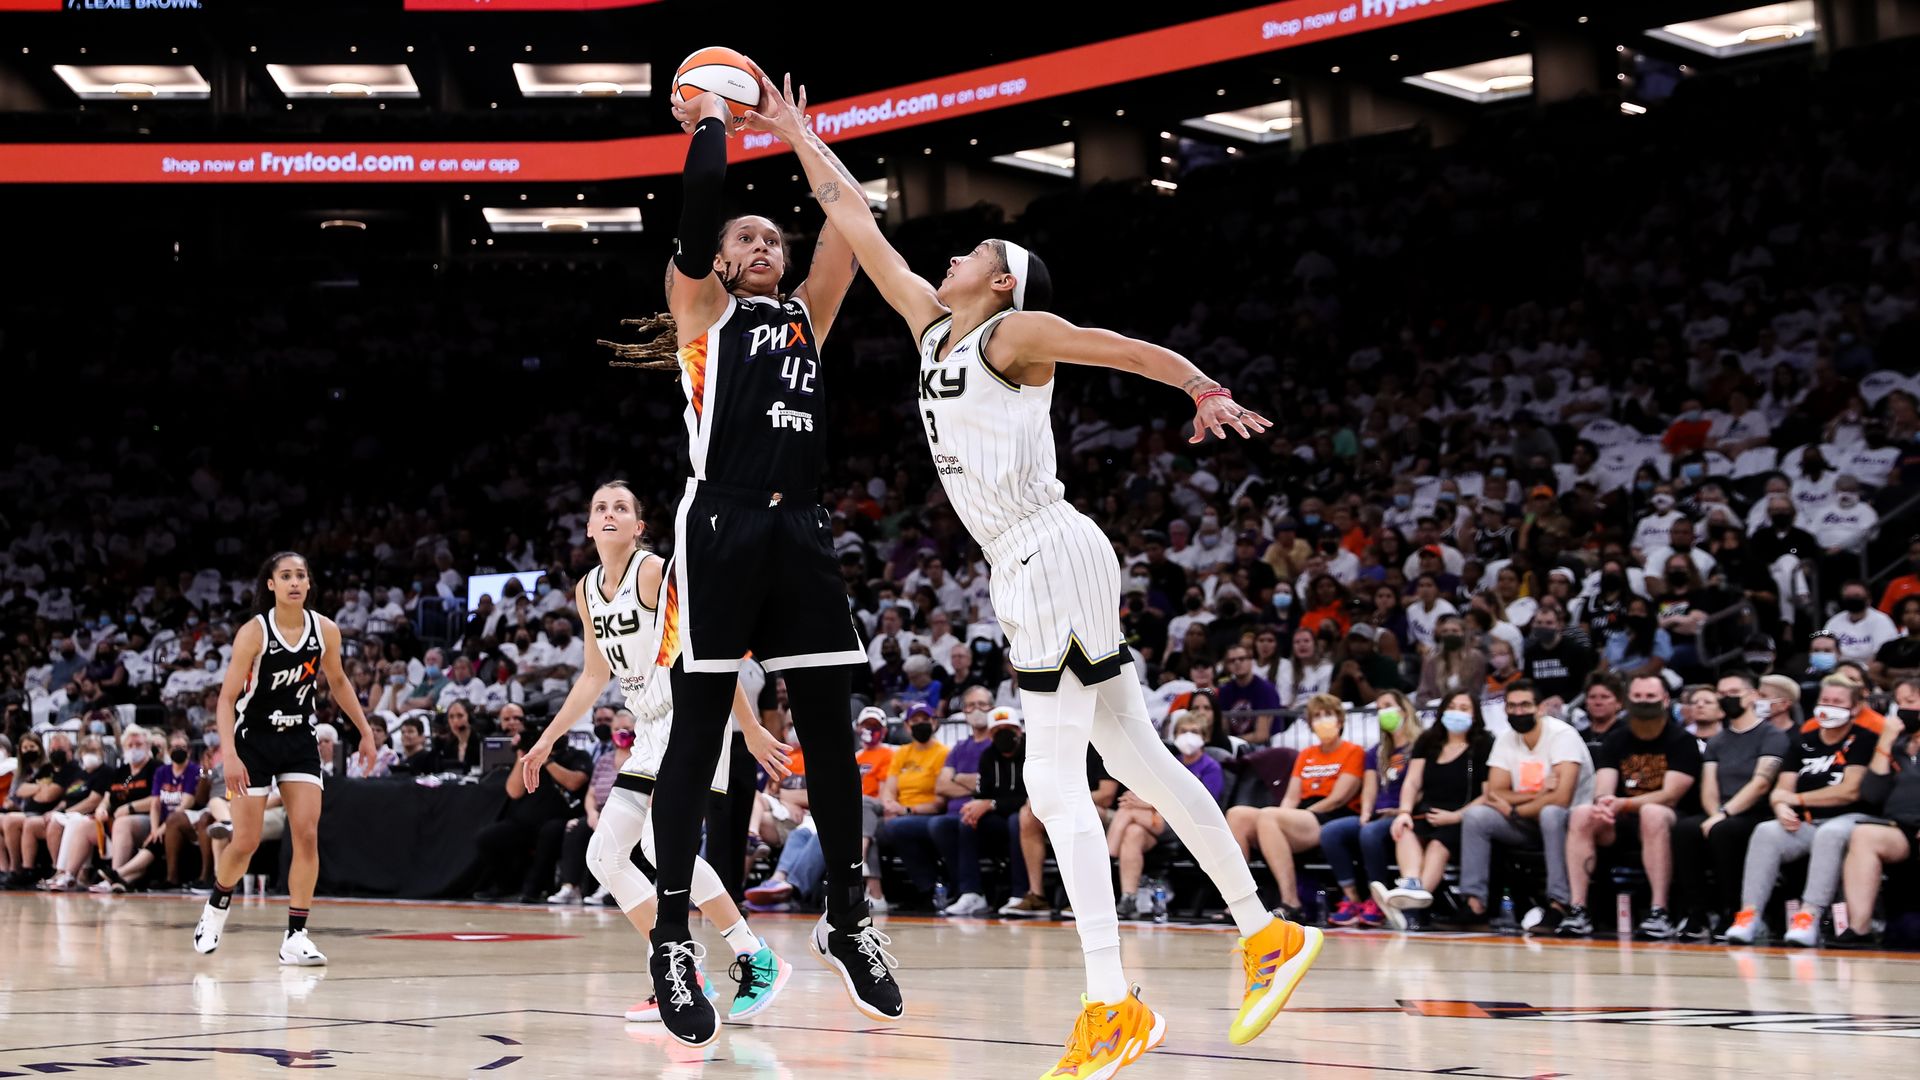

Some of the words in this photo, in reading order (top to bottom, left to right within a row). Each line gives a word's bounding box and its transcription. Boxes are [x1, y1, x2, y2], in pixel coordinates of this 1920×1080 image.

[85, 0, 131, 9] LEXIE
[1262, 18, 1301, 39] Shop
[1303, 10, 1336, 31] now
[1339, 5, 1356, 22] at
[816, 92, 938, 135] Frysfood.com
[941, 94, 955, 107] or
[957, 89, 975, 104] on
[976, 84, 997, 100] our
[999, 78, 1027, 95] app
[162, 157, 200, 174] Shop
[203, 159, 235, 172] now
[238, 157, 254, 172] at
[261, 152, 413, 176] Frysfood.com
[420, 159, 435, 171] or
[438, 159, 458, 171] on
[461, 159, 486, 171] our
[488, 159, 520, 173] app
[749, 322, 808, 357] PHX
[781, 356, 816, 393] 42
[919, 366, 967, 400] KY
[766, 401, 813, 432] fry's
[926, 409, 938, 444] 3
[593, 609, 639, 638] SKY
[271, 656, 317, 690] PHX
[606, 644, 628, 670] 14
[296, 684, 311, 706] 4
